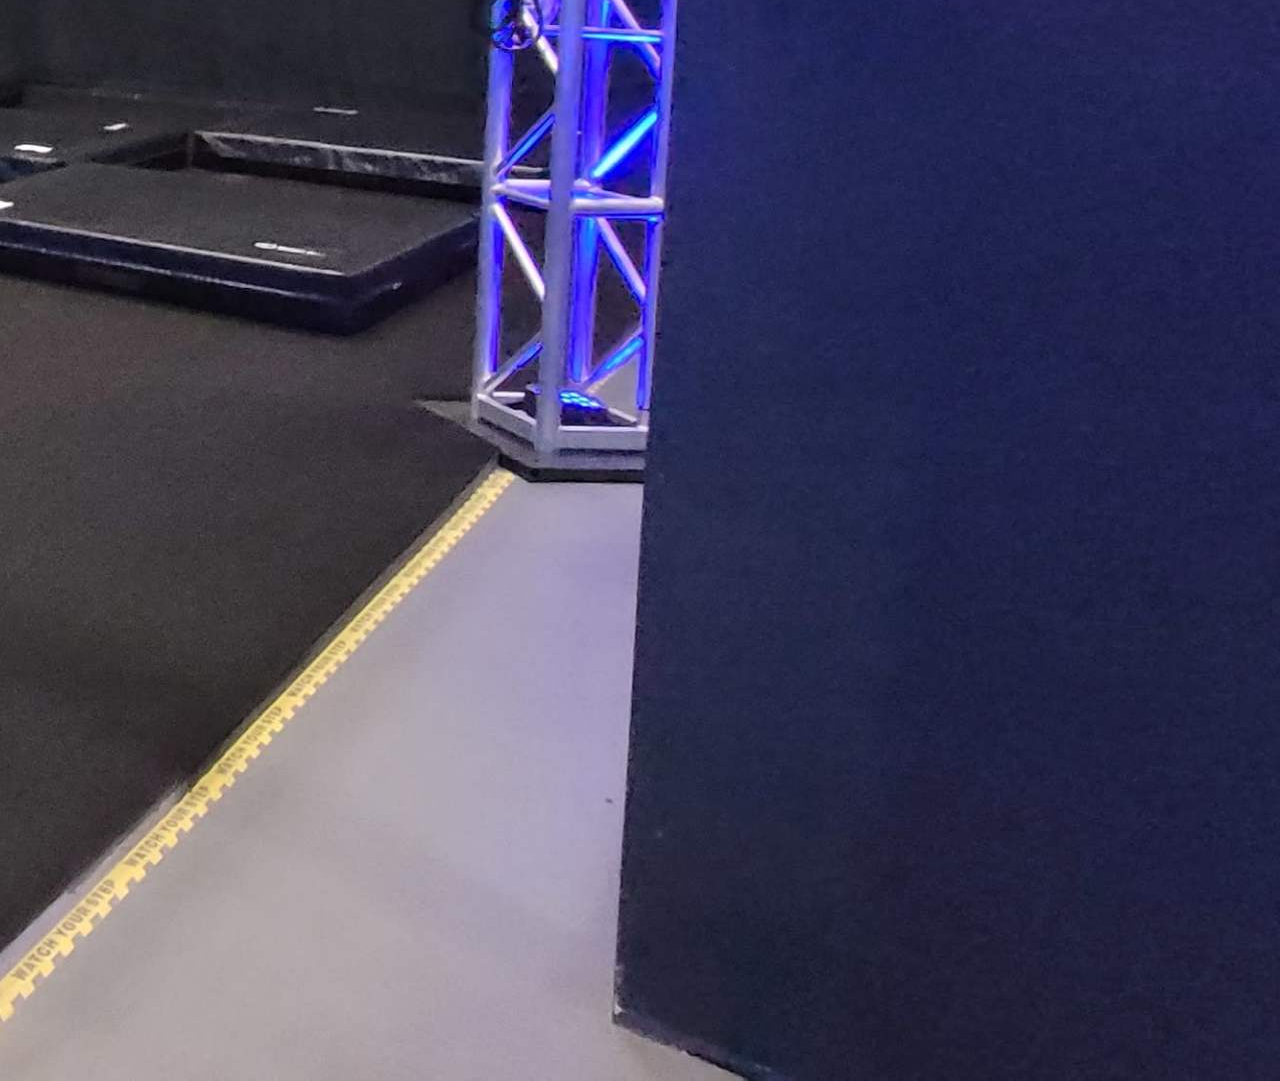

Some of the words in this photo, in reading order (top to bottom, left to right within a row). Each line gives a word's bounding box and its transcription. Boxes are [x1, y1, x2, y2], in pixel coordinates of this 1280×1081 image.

[123, 833, 165, 867] WATCH
[10, 937, 59, 981] WATCH
[53, 906, 91, 937] YOUR
[85, 879, 115, 907] STEP
